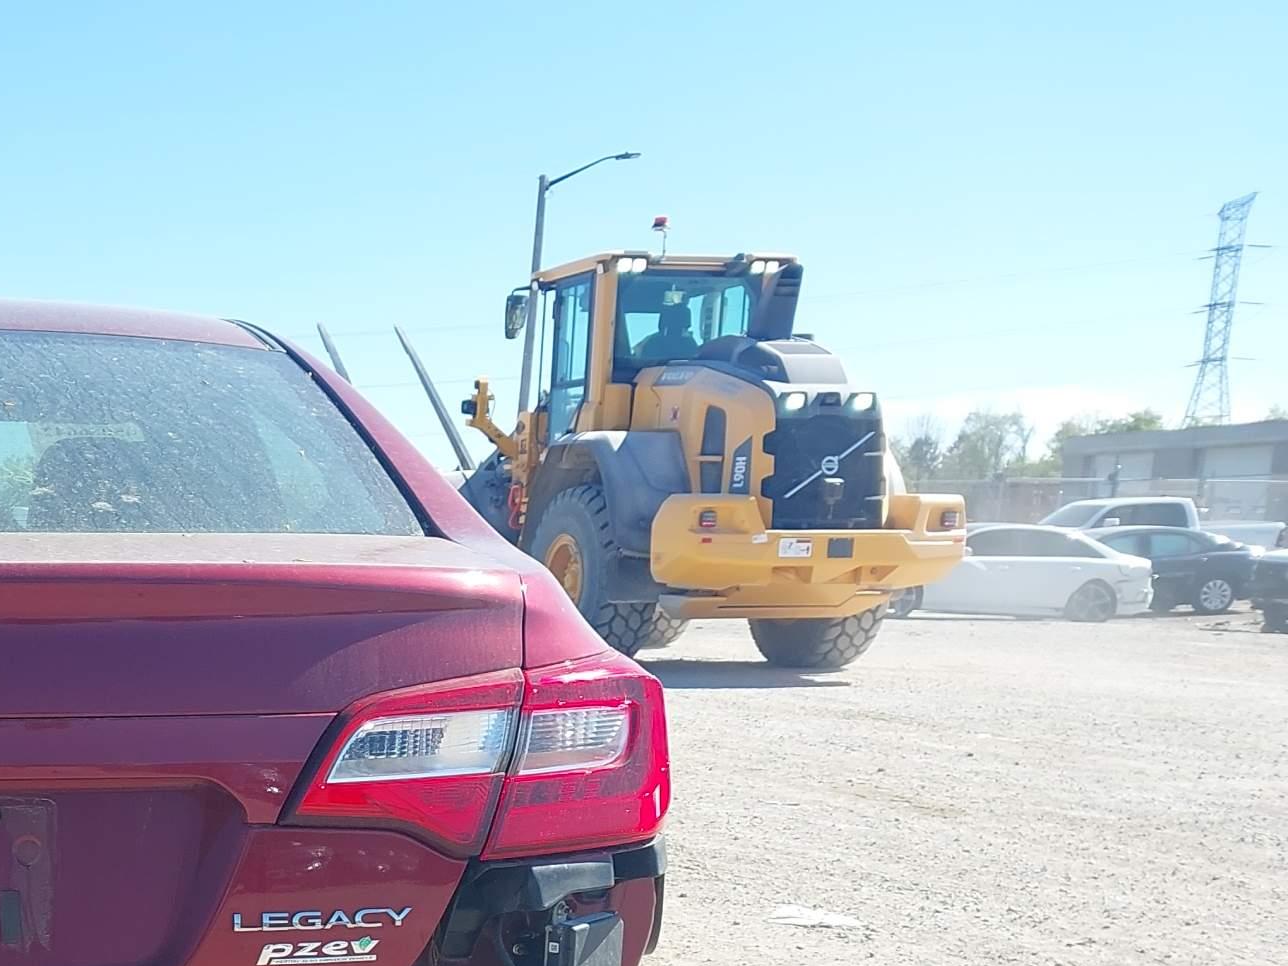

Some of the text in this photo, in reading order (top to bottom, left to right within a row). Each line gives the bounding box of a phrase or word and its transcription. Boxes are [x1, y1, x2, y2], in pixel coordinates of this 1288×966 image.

[732, 456, 748, 488] L90H
[233, 907, 412, 932] LEGACY
[256, 936, 380, 966] pzev
